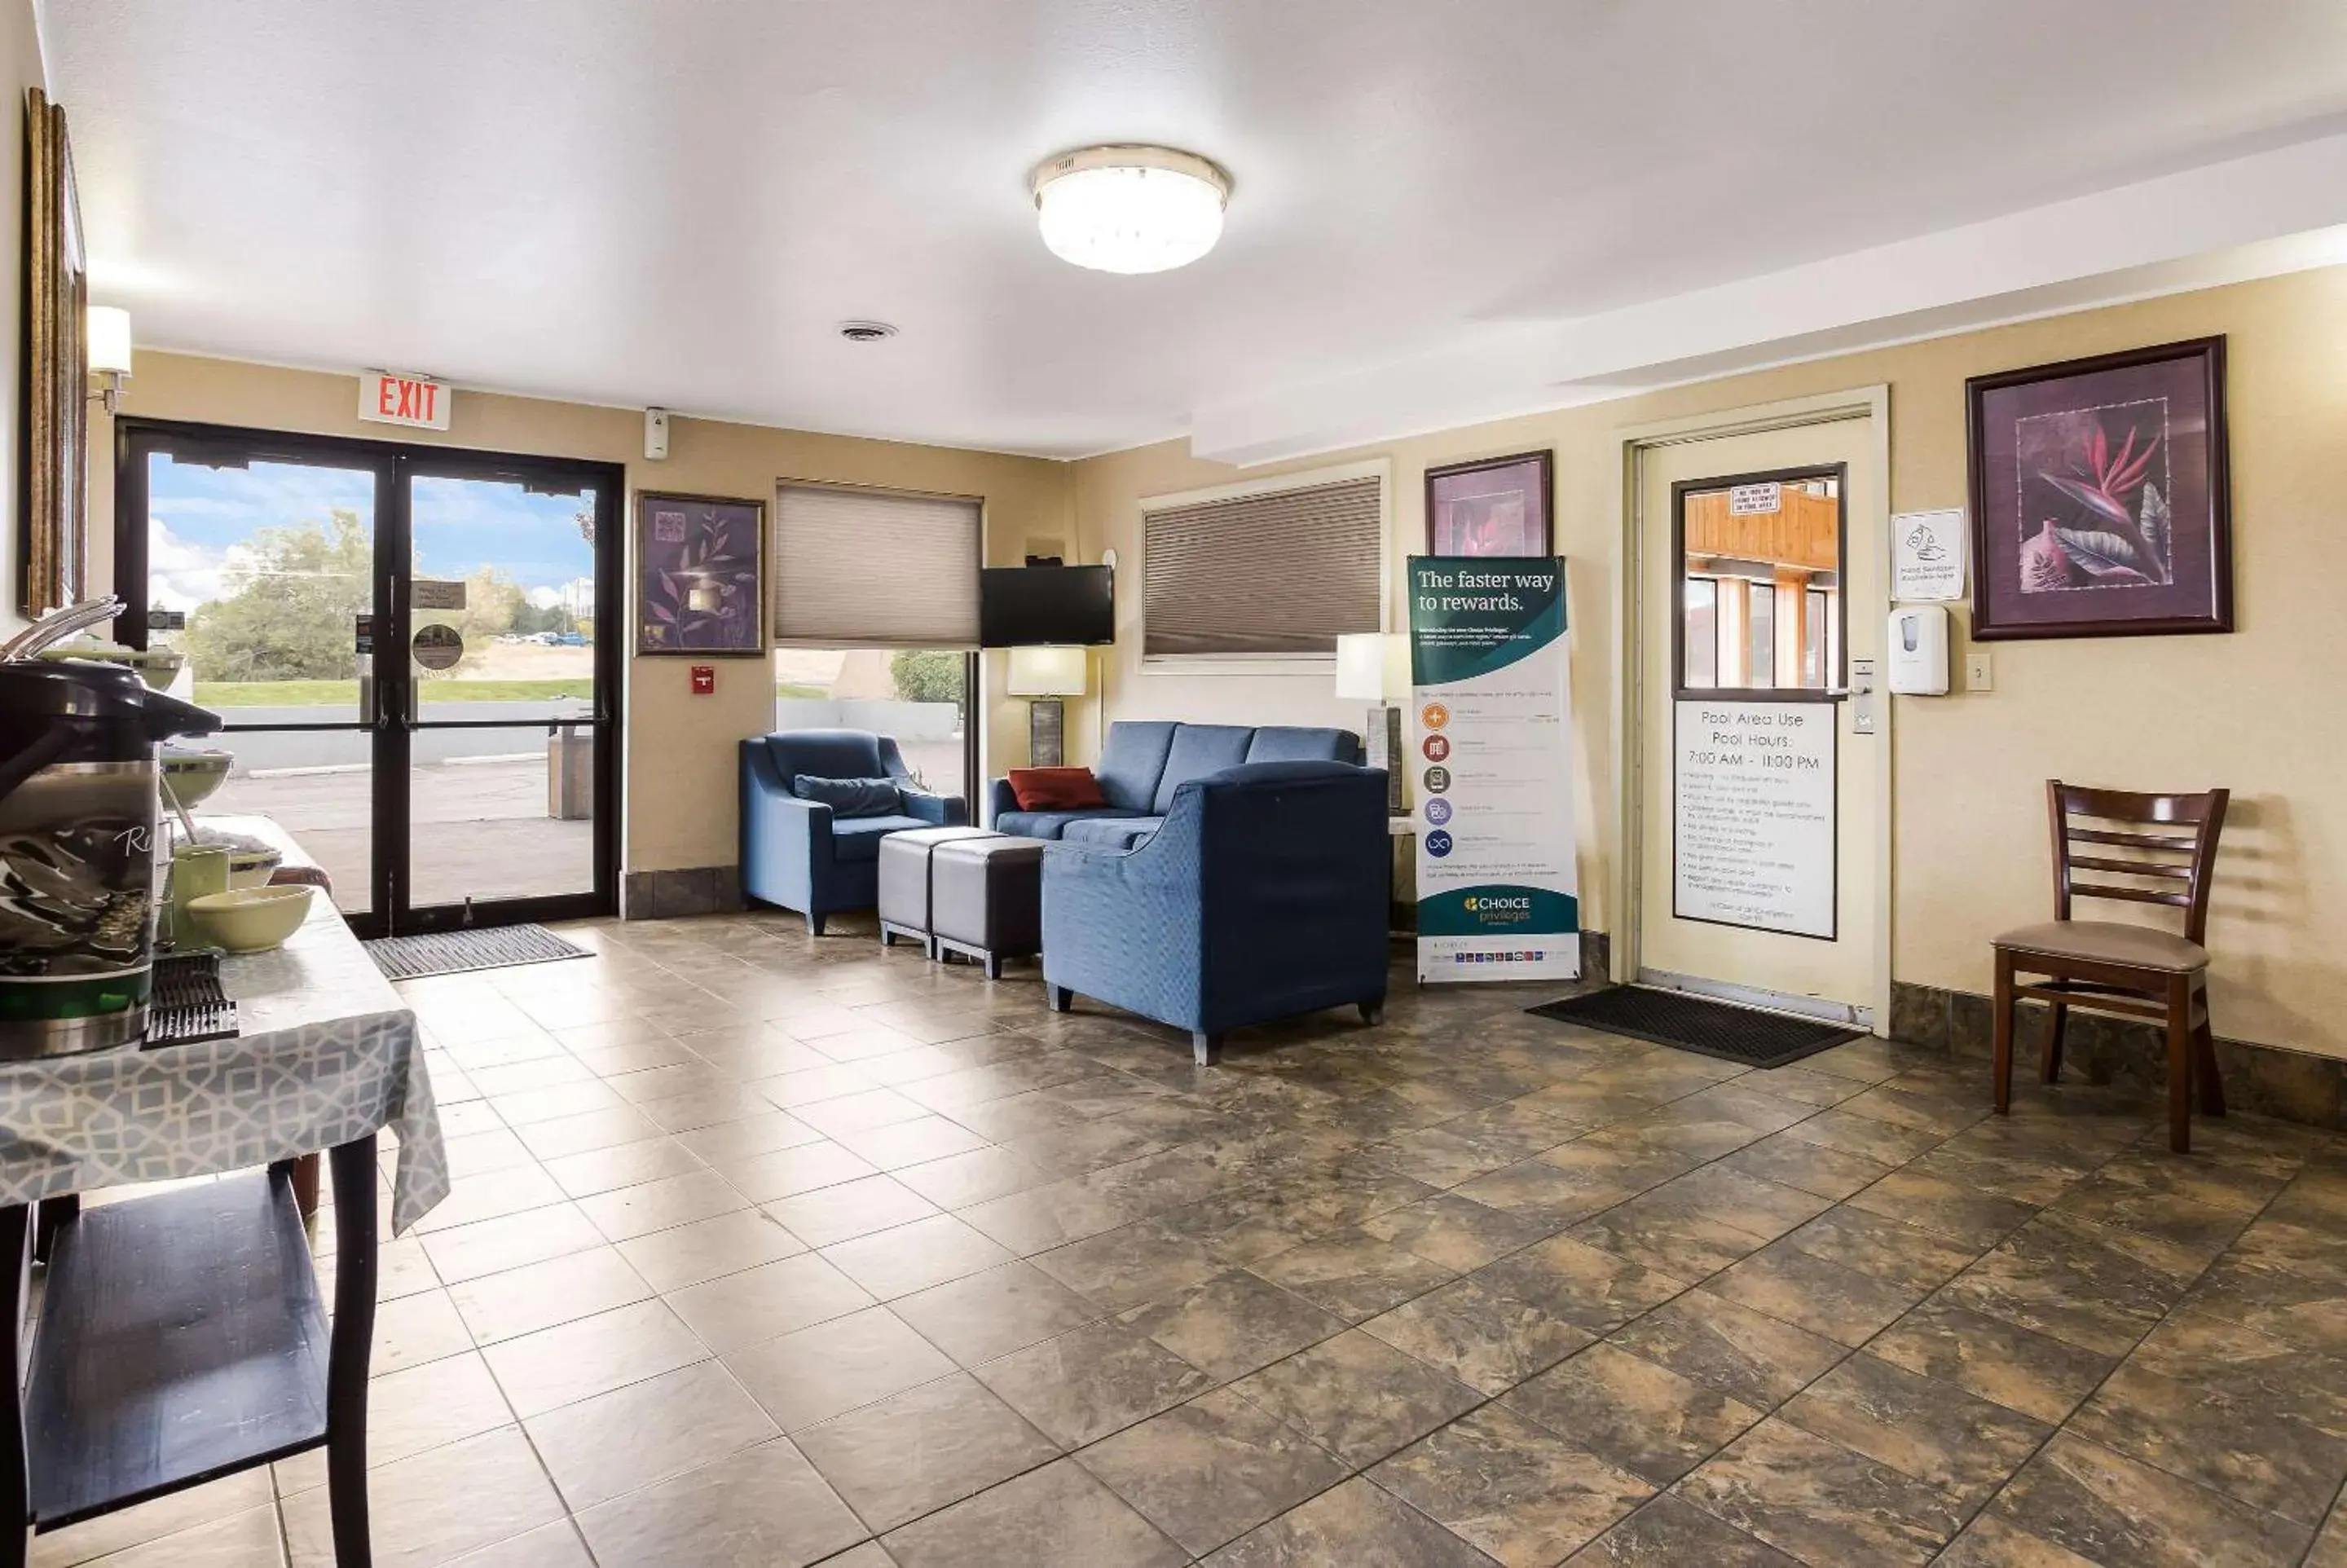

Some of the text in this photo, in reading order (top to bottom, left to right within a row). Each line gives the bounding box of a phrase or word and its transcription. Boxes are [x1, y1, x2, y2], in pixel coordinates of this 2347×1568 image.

[379, 377, 438, 421] EXIT
[1417, 570, 1554, 592] The faster way
[1418, 592, 1524, 611] to rewards.
[1702, 711, 1803, 727] Pool Area Use
[1712, 731, 1742, 745] Pool
[1689, 750, 1716, 764] 7:00
[1720, 753, 1743, 765] AM
[1763, 755, 1793, 769] 11:00
[1797, 755, 1820, 769] PM
[1478, 897, 1530, 910] CHOICE
